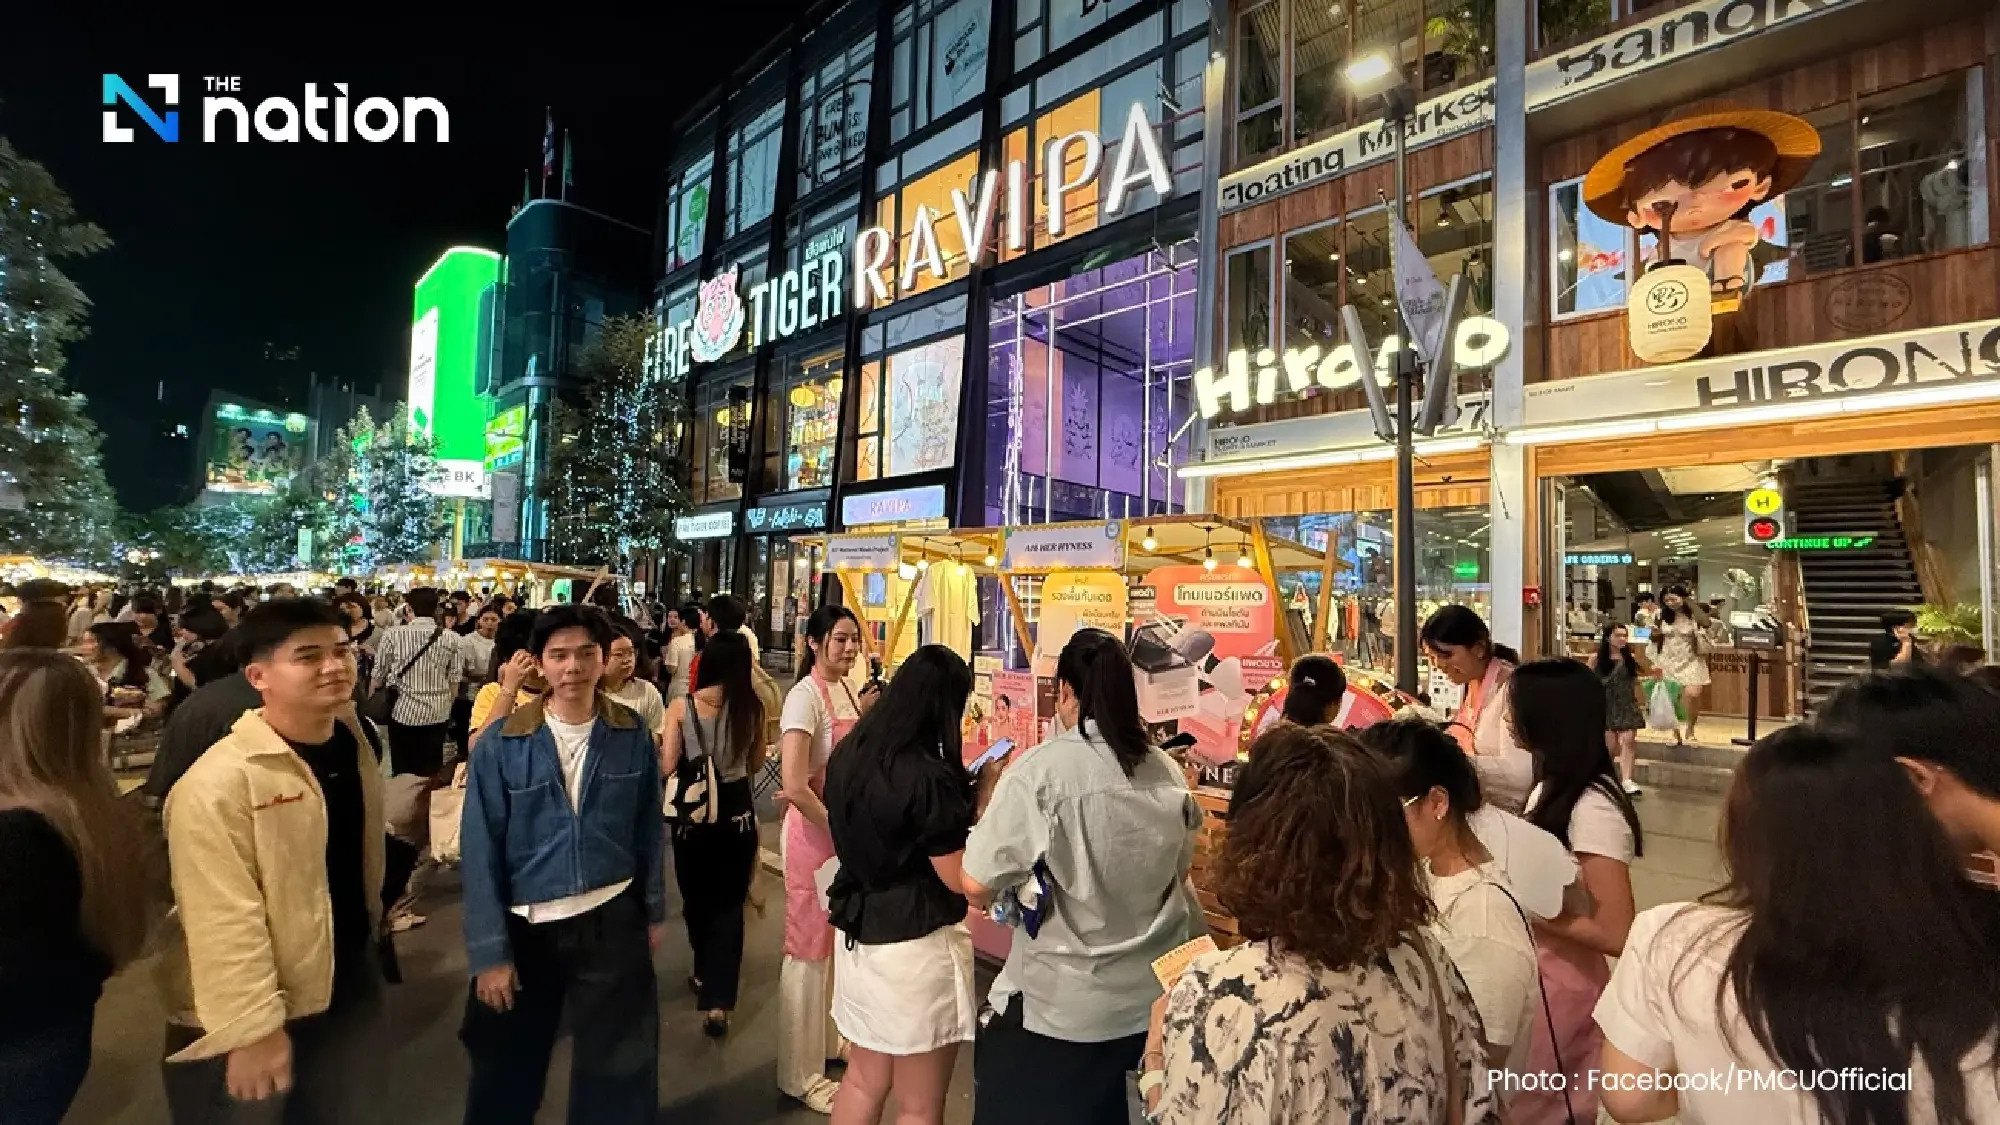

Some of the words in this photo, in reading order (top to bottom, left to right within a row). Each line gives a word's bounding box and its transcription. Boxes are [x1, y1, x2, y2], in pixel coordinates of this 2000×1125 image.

[1222, 147, 1344, 204] Floating
[855, 102, 1172, 309] RAVIPA
[643, 320, 692, 382] FIRE
[751, 251, 843, 346] TIGER
[1832, 537, 1852, 548] UP
[1178, 585, 1262, 601] โทนเนอร์แพด
